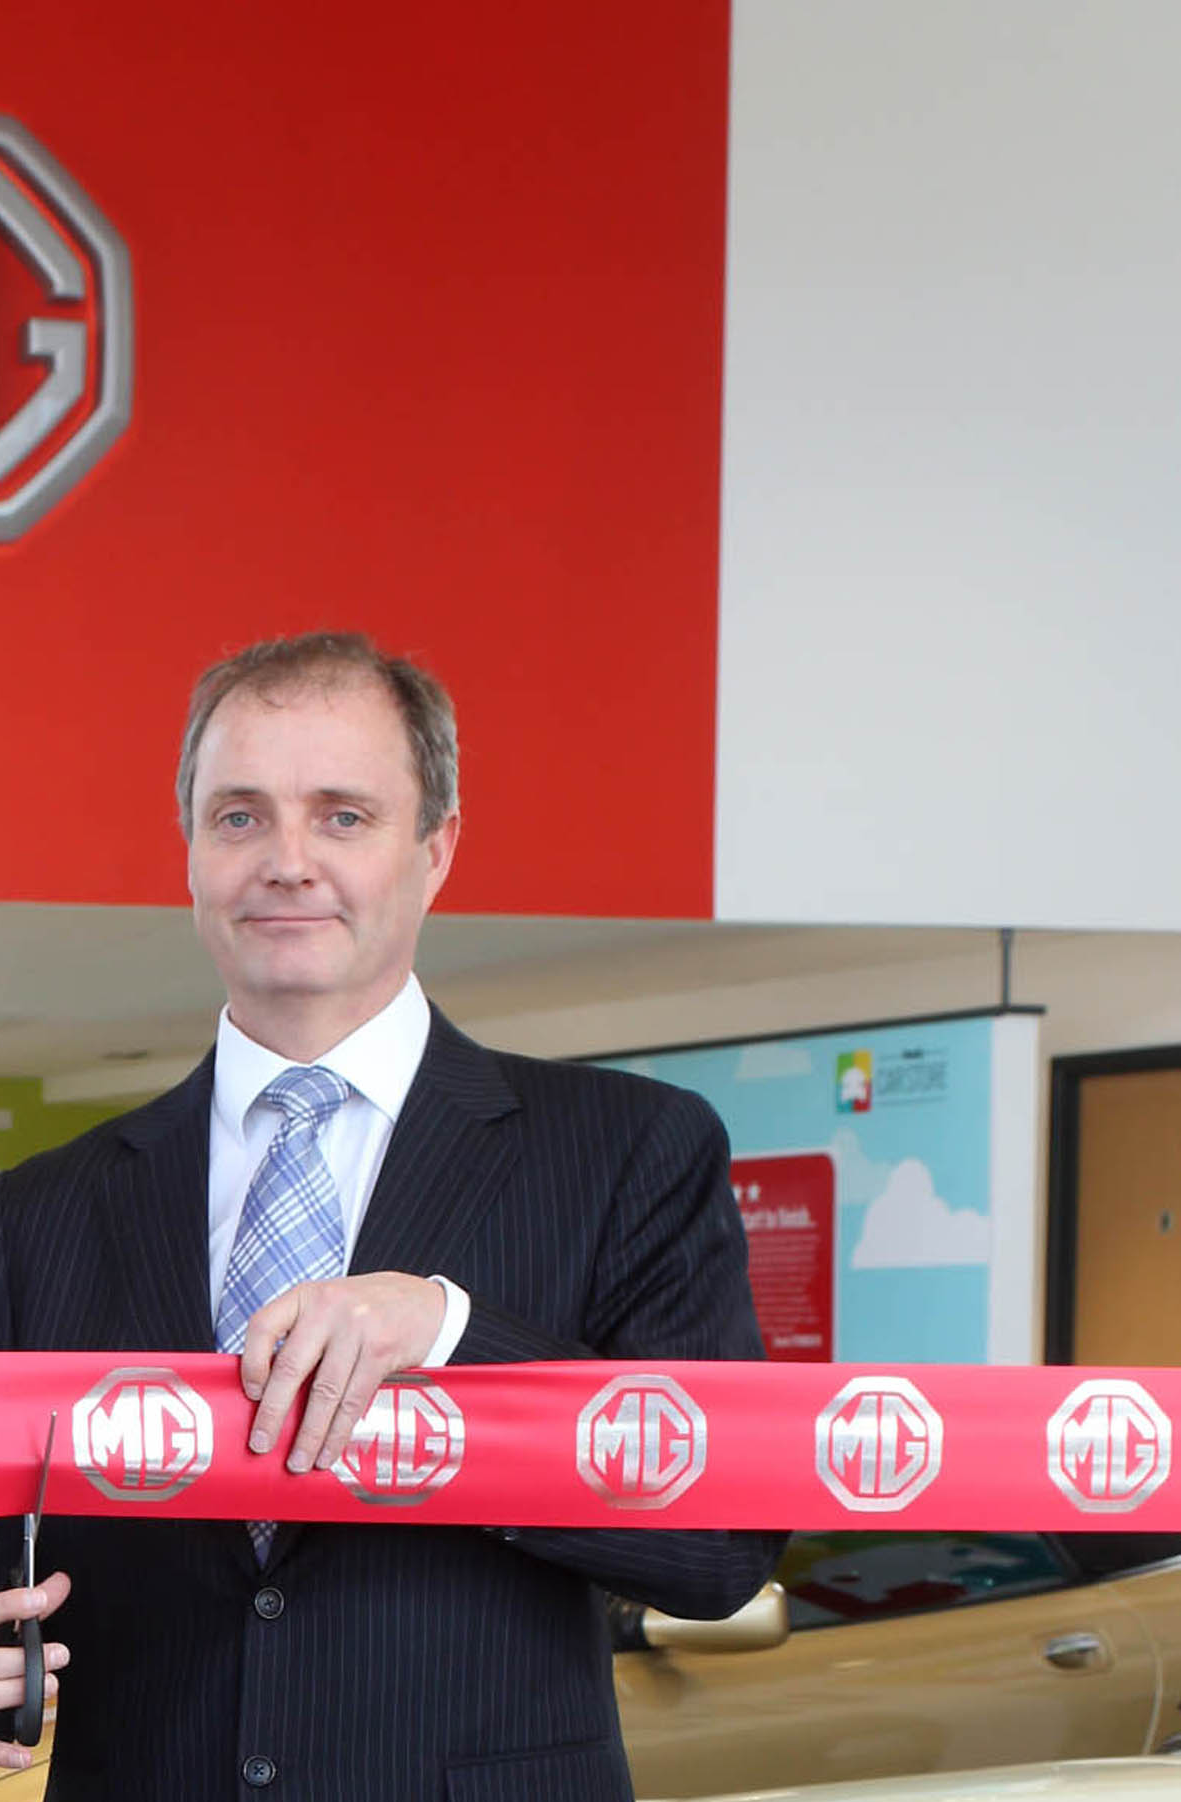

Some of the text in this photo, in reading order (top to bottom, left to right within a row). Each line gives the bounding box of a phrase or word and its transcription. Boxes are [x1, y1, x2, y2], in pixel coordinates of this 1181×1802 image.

[87, 1386, 194, 1489] MG
[346, 1384, 444, 1488] MG
[594, 1391, 687, 1493] MG
[831, 1394, 928, 1495] MG
[1062, 1395, 1156, 1495] MG
